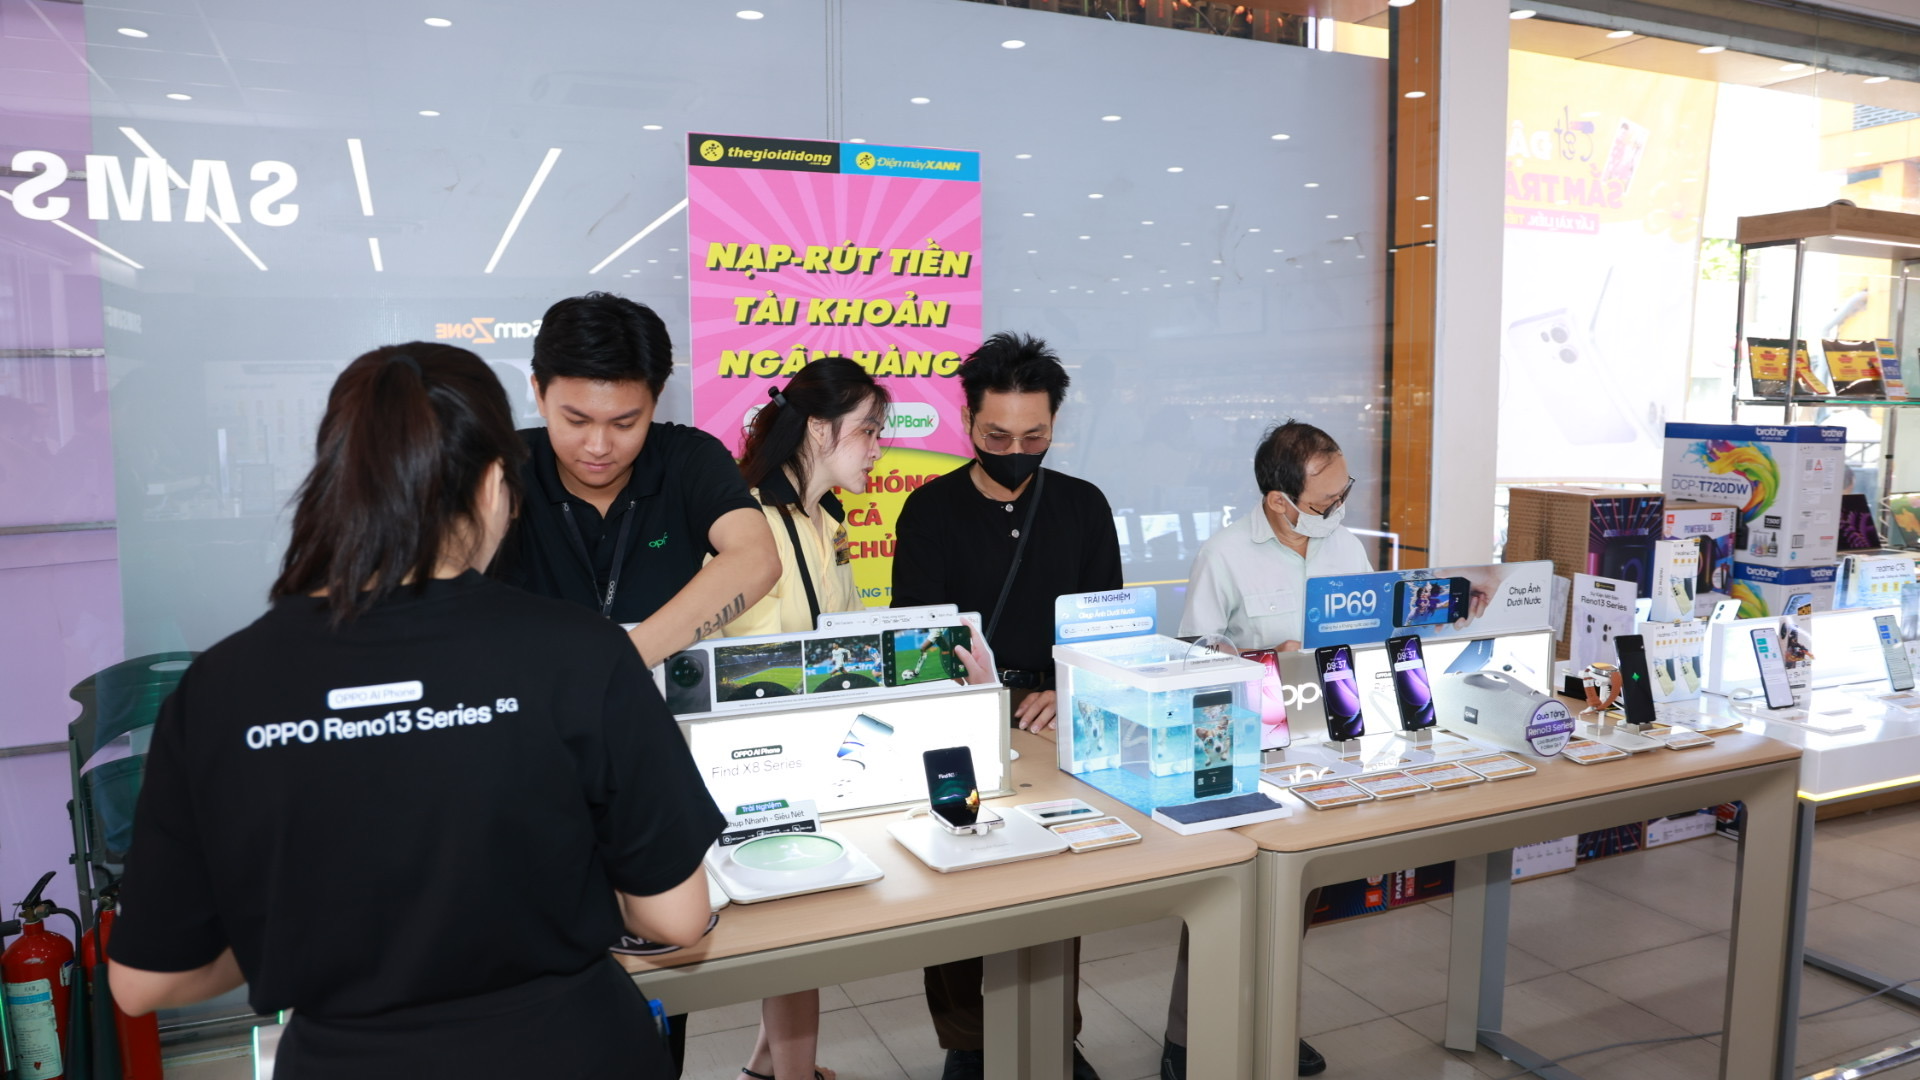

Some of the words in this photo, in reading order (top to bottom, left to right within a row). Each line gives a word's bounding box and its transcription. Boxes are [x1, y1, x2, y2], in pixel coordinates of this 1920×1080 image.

[727, 147, 832, 166] thegioididong
[705, 239, 881, 280] NẠP-RÚT
[889, 237, 971, 277] TIỀN
[733, 289, 799, 325] TÀI
[805, 291, 950, 327] KHOẢN
[888, 415, 934, 428] VPBank
[1755, 428, 1789, 436] brother
[1821, 429, 1844, 438] brother
[1671, 478, 1749, 495] DCP-T720DW
[847, 502, 882, 526] CẢ
[1746, 566, 1780, 578] brother
[1810, 568, 1834, 578] brother
[607, 581, 616, 605] oppo
[1509, 586, 1526, 595] Chụp
[1528, 582, 1541, 593] Ảnh
[1102, 592, 1131, 603] NGHIỆM
[1325, 589, 1377, 618] IP69
[1581, 596, 1605, 607] Reno13
[1606, 600, 1628, 611] Series
[1205, 645, 1220, 655] 2M
[1396, 651, 1416, 660] 09:37
[1326, 660, 1346, 670] 09:37
[334, 691, 368, 704] OPPO
[383, 687, 417, 699] Phone
[1536, 712, 1550, 720] Quà
[1550, 710, 1566, 719] Tặng
[246, 719, 319, 749] OPPO
[323, 710, 413, 742] Reno13
[416, 703, 492, 730] Series
[495, 698, 519, 713] 5G
[1528, 724, 1552, 737] Reno13
[1552, 720, 1574, 732] Series
[733, 749, 753, 758] OPPO
[761, 746, 781, 755] Phone
[712, 764, 739, 779] Find
[743, 761, 760, 775] X8
[763, 759, 802, 772] Series
[756, 802, 782, 812] Nghiệm
[744, 816, 768, 825] Nhanh
[774, 812, 790, 821] Siêu
[790, 810, 804, 818] Nét
